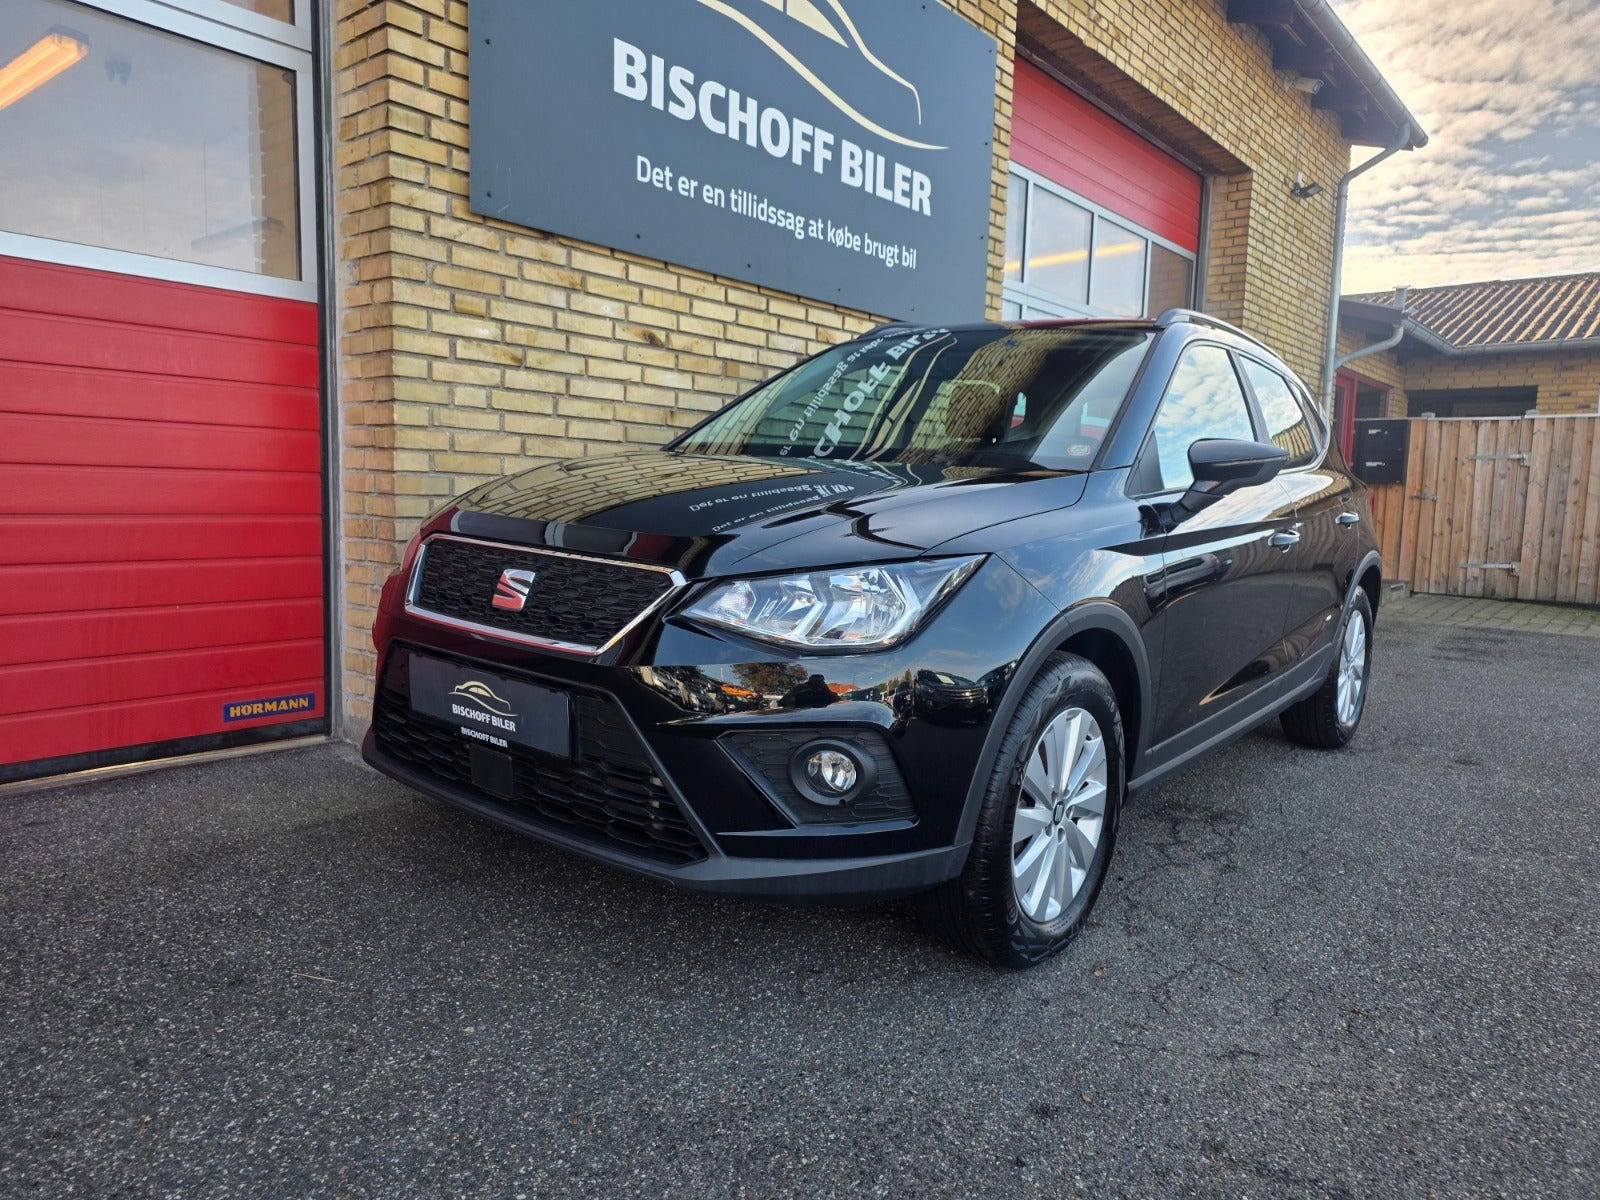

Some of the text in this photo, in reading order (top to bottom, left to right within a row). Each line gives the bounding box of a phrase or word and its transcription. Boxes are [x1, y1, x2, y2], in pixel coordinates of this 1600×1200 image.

[613, 37, 932, 216] BISCHOFF BILER
[636, 154, 917, 269] Det er en tillidssag at købe brugt bil
[229, 697, 309, 718] HÖRMANN
[452, 704, 516, 732] BISCHOFF BILER
[461, 727, 508, 748] BISCHOFF BILER
